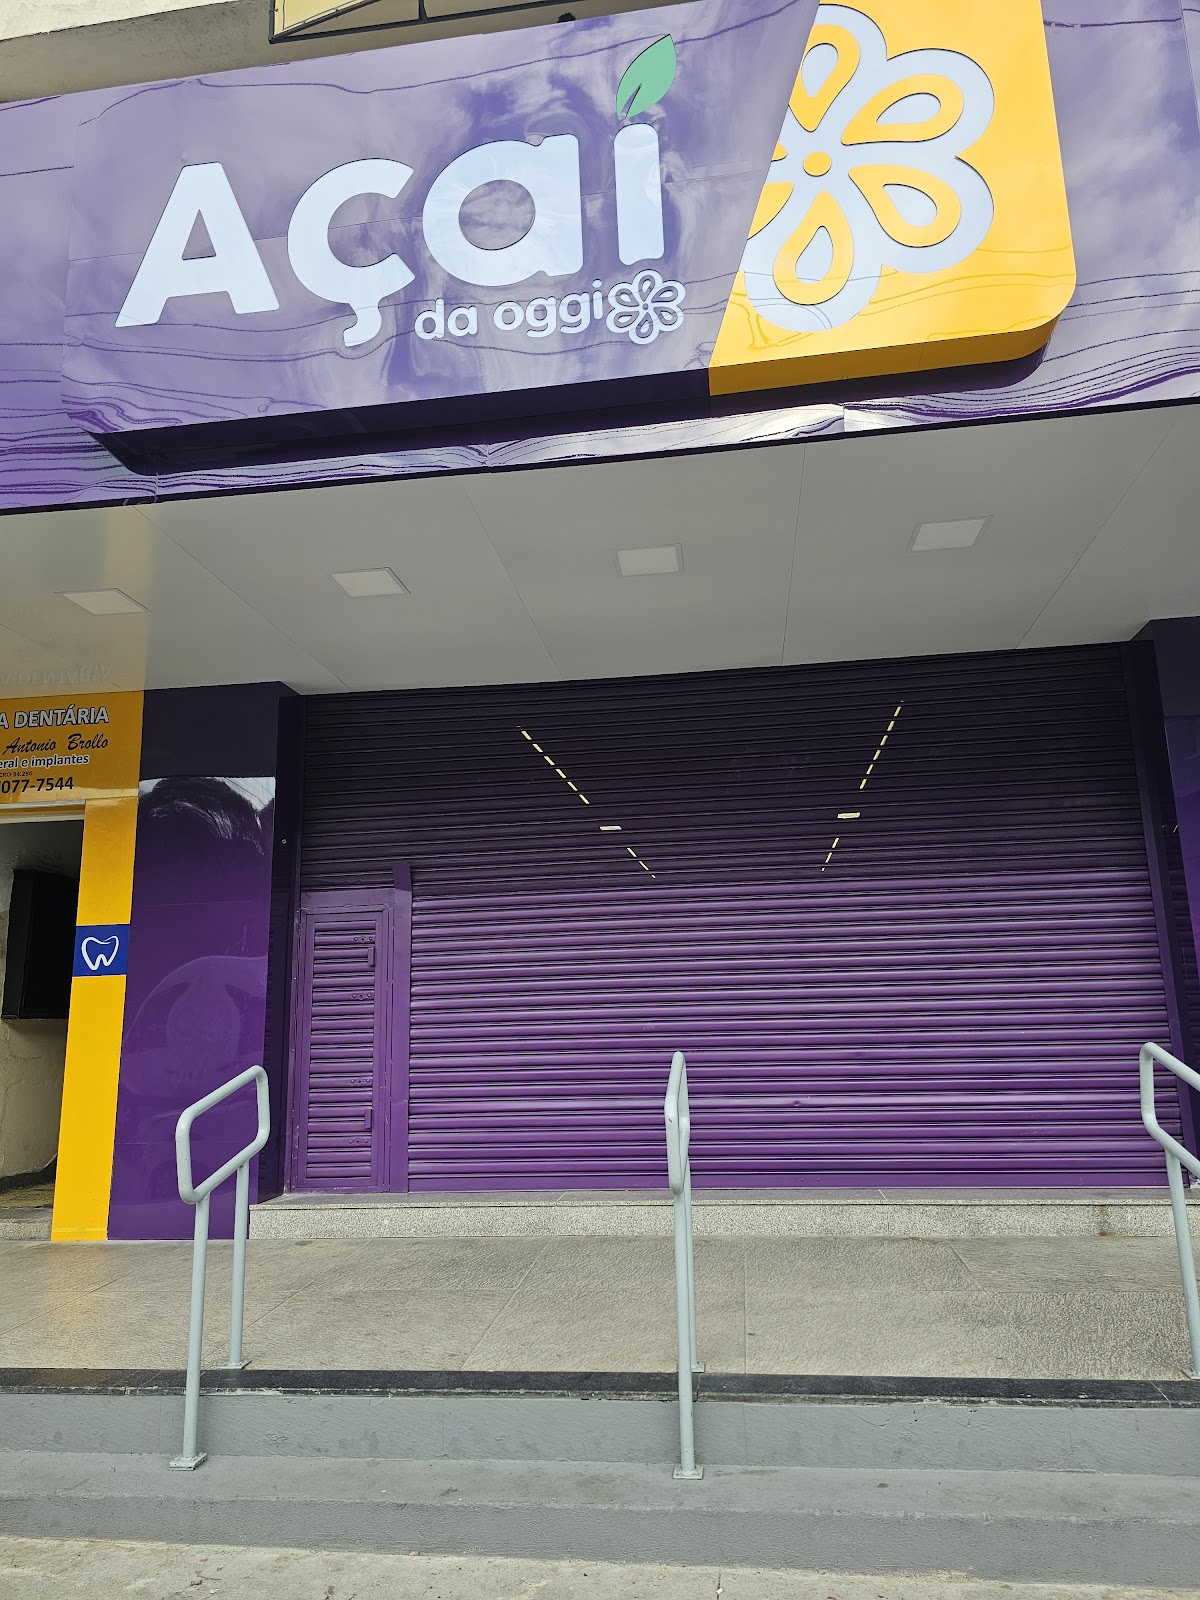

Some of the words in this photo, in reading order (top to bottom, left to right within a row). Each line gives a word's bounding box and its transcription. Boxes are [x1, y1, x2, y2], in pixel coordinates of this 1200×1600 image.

[414, 298, 478, 340] da
[493, 279, 603, 338] oggi
[14, 704, 110, 729] DENTÁRIA
[3, 737, 57, 755] Antonio
[67, 733, 109, 751] Brollo
[20, 758, 29, 768] e
[31, 753, 90, 769] implantes
[0, 776, 74, 794] 077-7544
